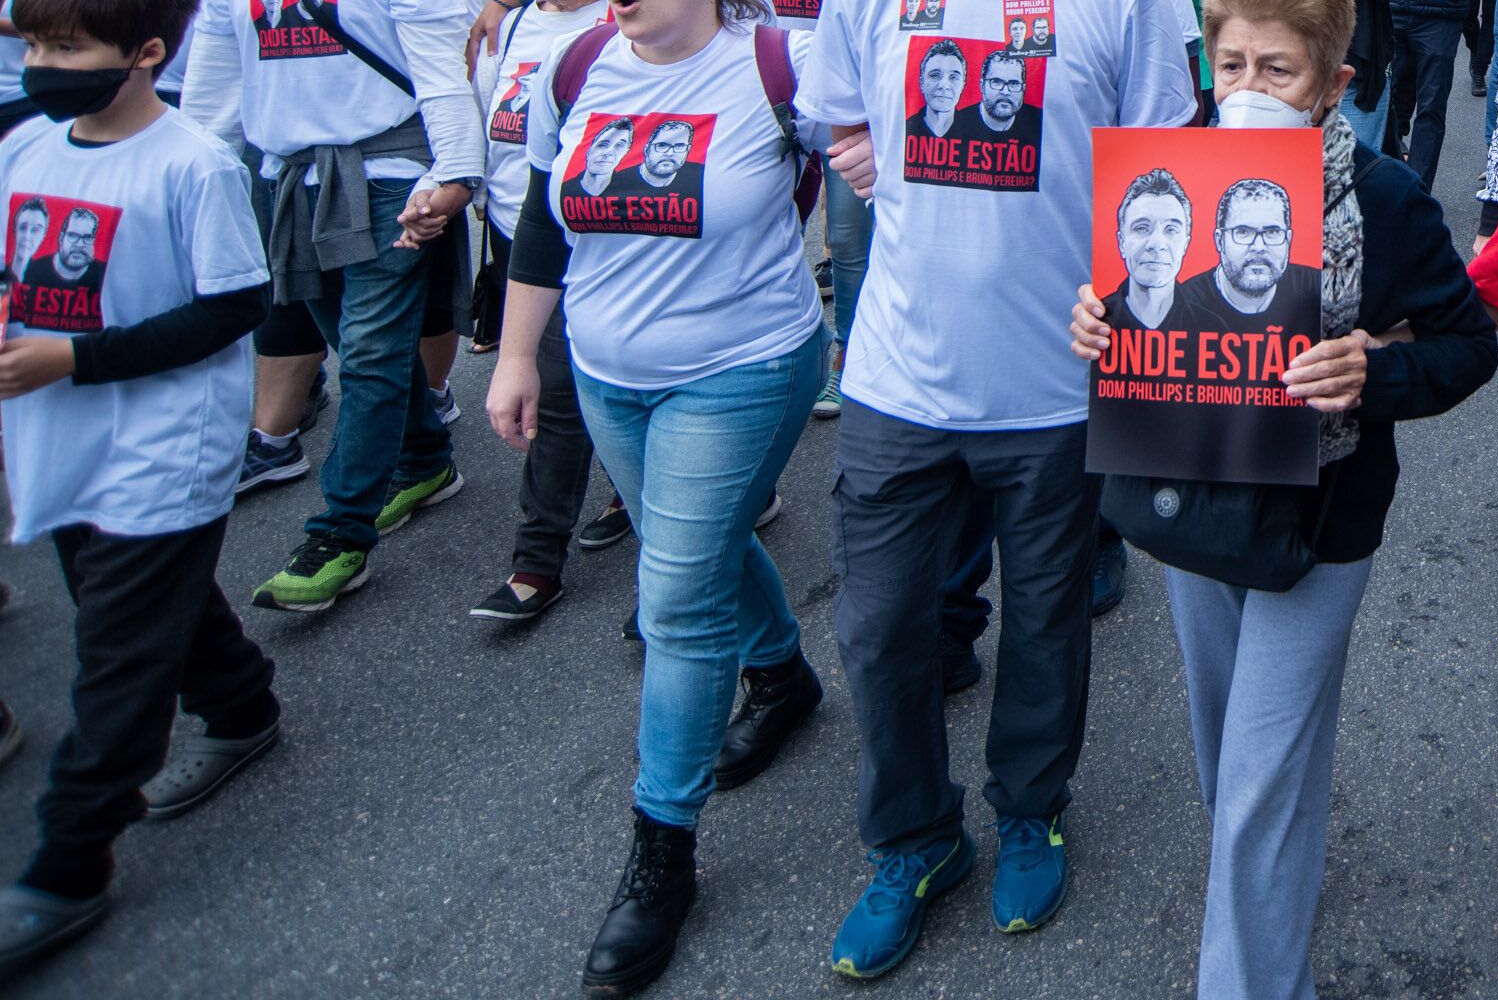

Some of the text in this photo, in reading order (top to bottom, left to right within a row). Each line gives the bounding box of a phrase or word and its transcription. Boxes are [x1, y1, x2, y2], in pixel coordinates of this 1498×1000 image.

[493, 111, 526, 132] ONDE
[906, 135, 1036, 173] ONDE ESTÃO
[905, 166, 1035, 187] DOM PHILLIPS E BRUNO PEREIRA?
[563, 193, 698, 223] ONDE ESTÃO
[586, 221, 623, 231] PHILLIPS
[624, 222, 631, 231] E
[631, 222, 658, 233] BRUNO
[659, 223, 698, 235] PEREIRA?
[59, 316, 99, 330] PEREIRA
[1099, 328, 1187, 377] ONDE
[1098, 380, 1125, 399] DOM
[1128, 381, 1182, 402] PHILLIPS
[1186, 385, 1193, 401] E
[1198, 385, 1242, 405] BRUNO
